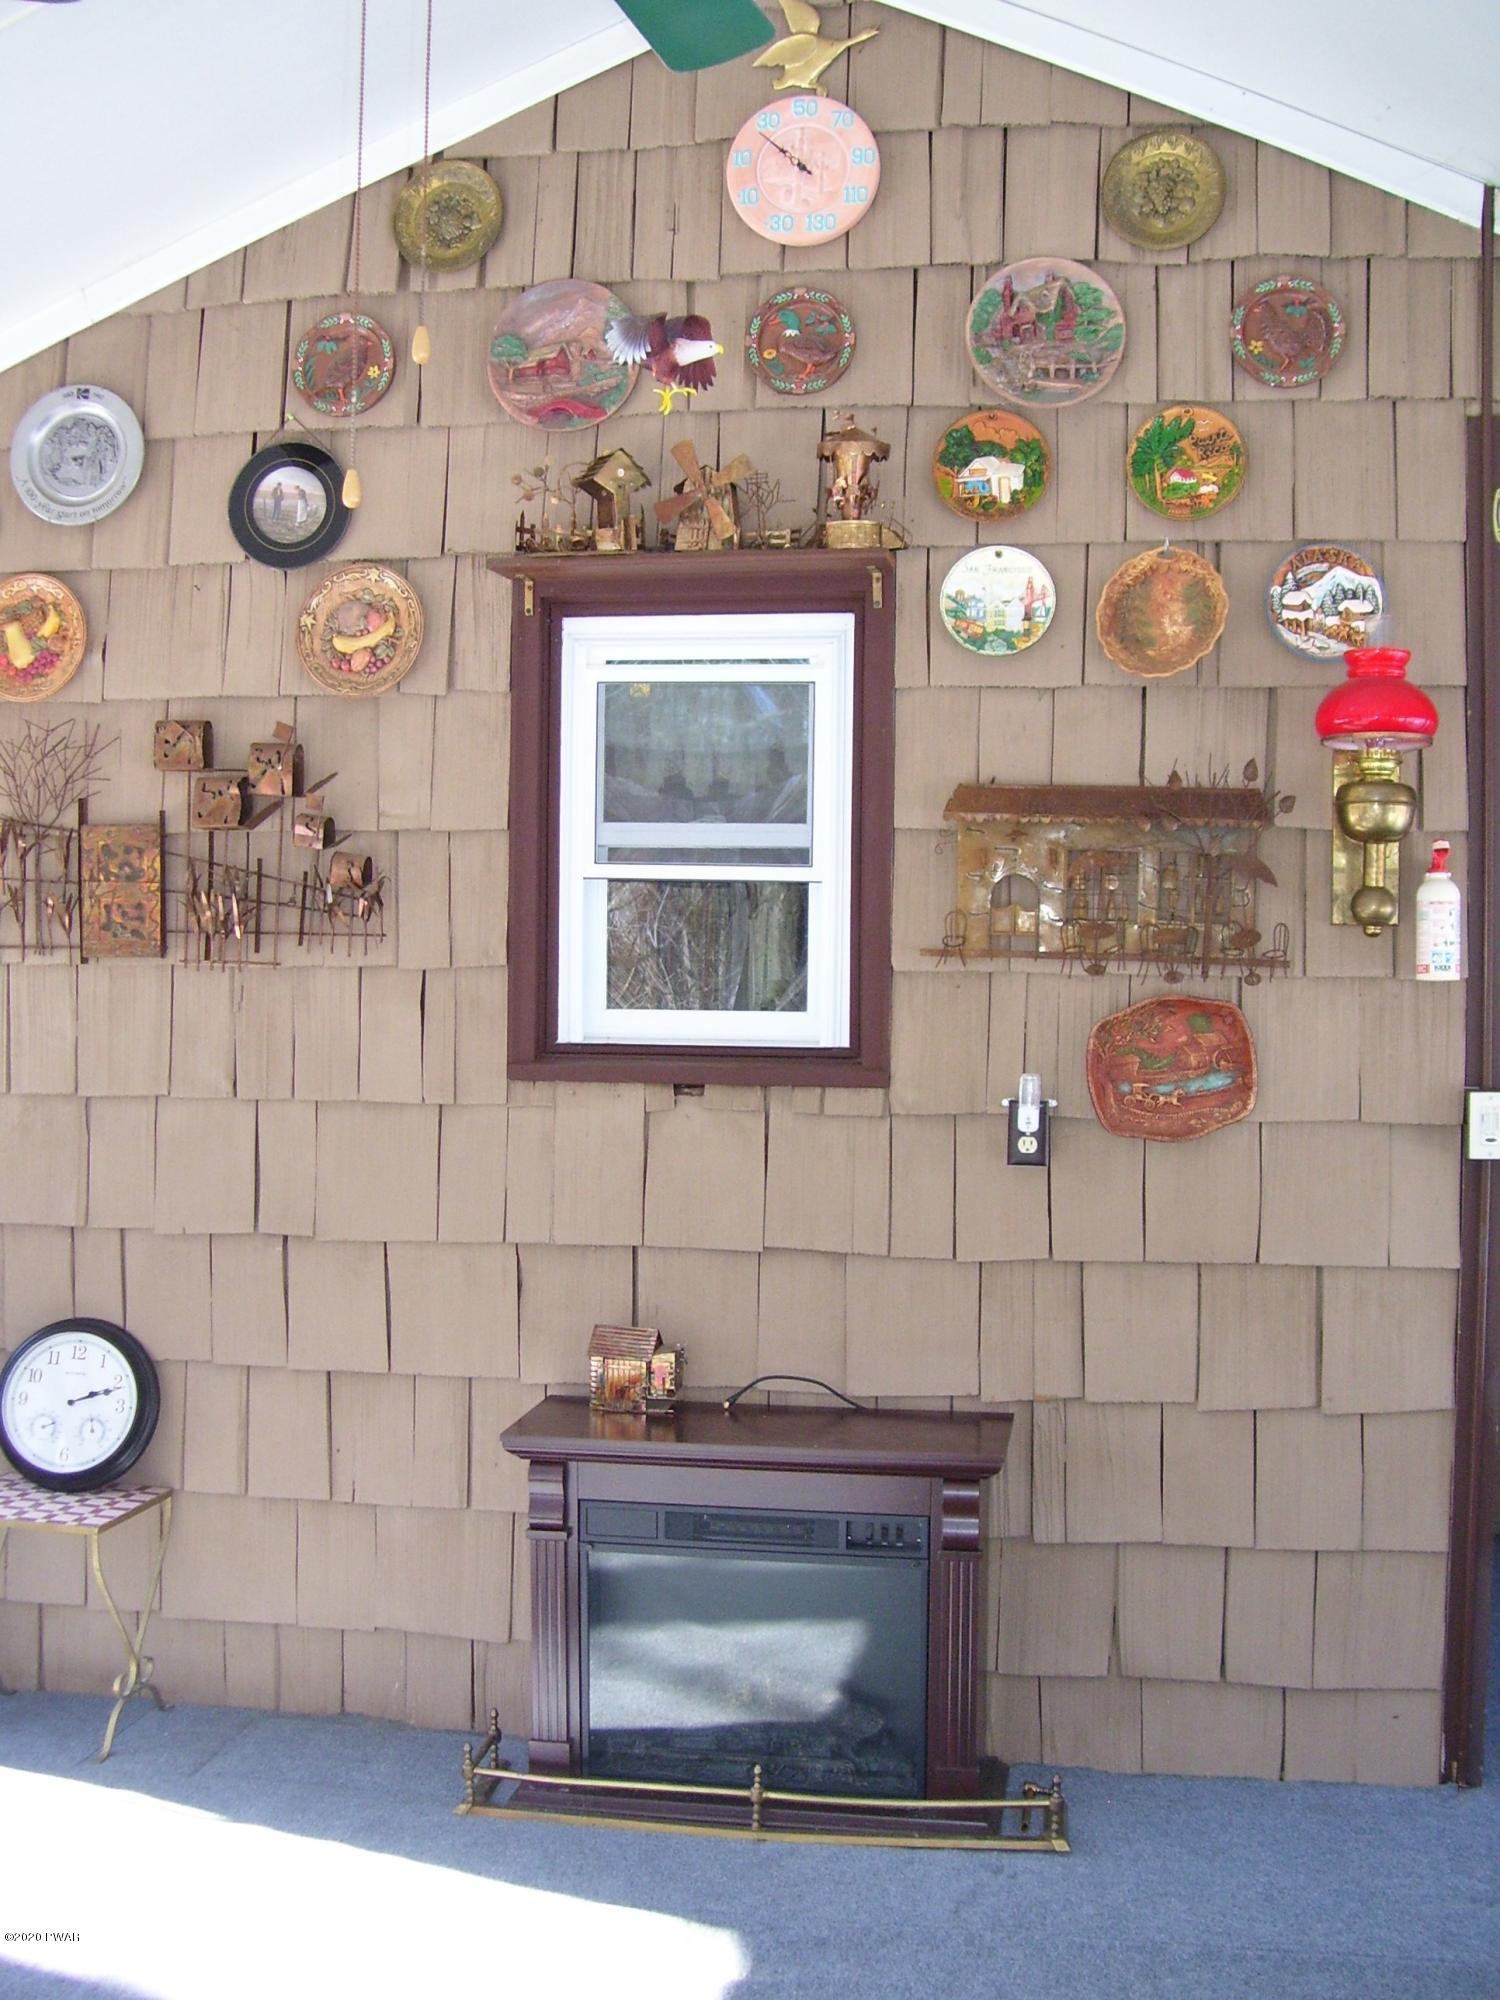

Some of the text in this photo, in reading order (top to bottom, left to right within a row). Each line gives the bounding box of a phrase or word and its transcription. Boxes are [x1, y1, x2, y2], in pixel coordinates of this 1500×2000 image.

[792, 99, 818, 116] 50
[756, 112, 780, 129] 30
[831, 111, 854, 128] 70
[733, 149, 752, 167] 10
[852, 147, 876, 165] 90
[843, 187, 868, 204] 110
[806, 213, 836, 231] 130
[48, 1351, 61, 1366] 11
[71, 1345, 87, 1361] 12
[100, 1353, 107, 1369] 1
[28, 1368, 43, 1383] 10
[113, 1374, 123, 1390] 2
[18, 1391, 29, 1406] 9
[115, 1399, 125, 1414] 3
[59, 1447, 70, 1462] 6
